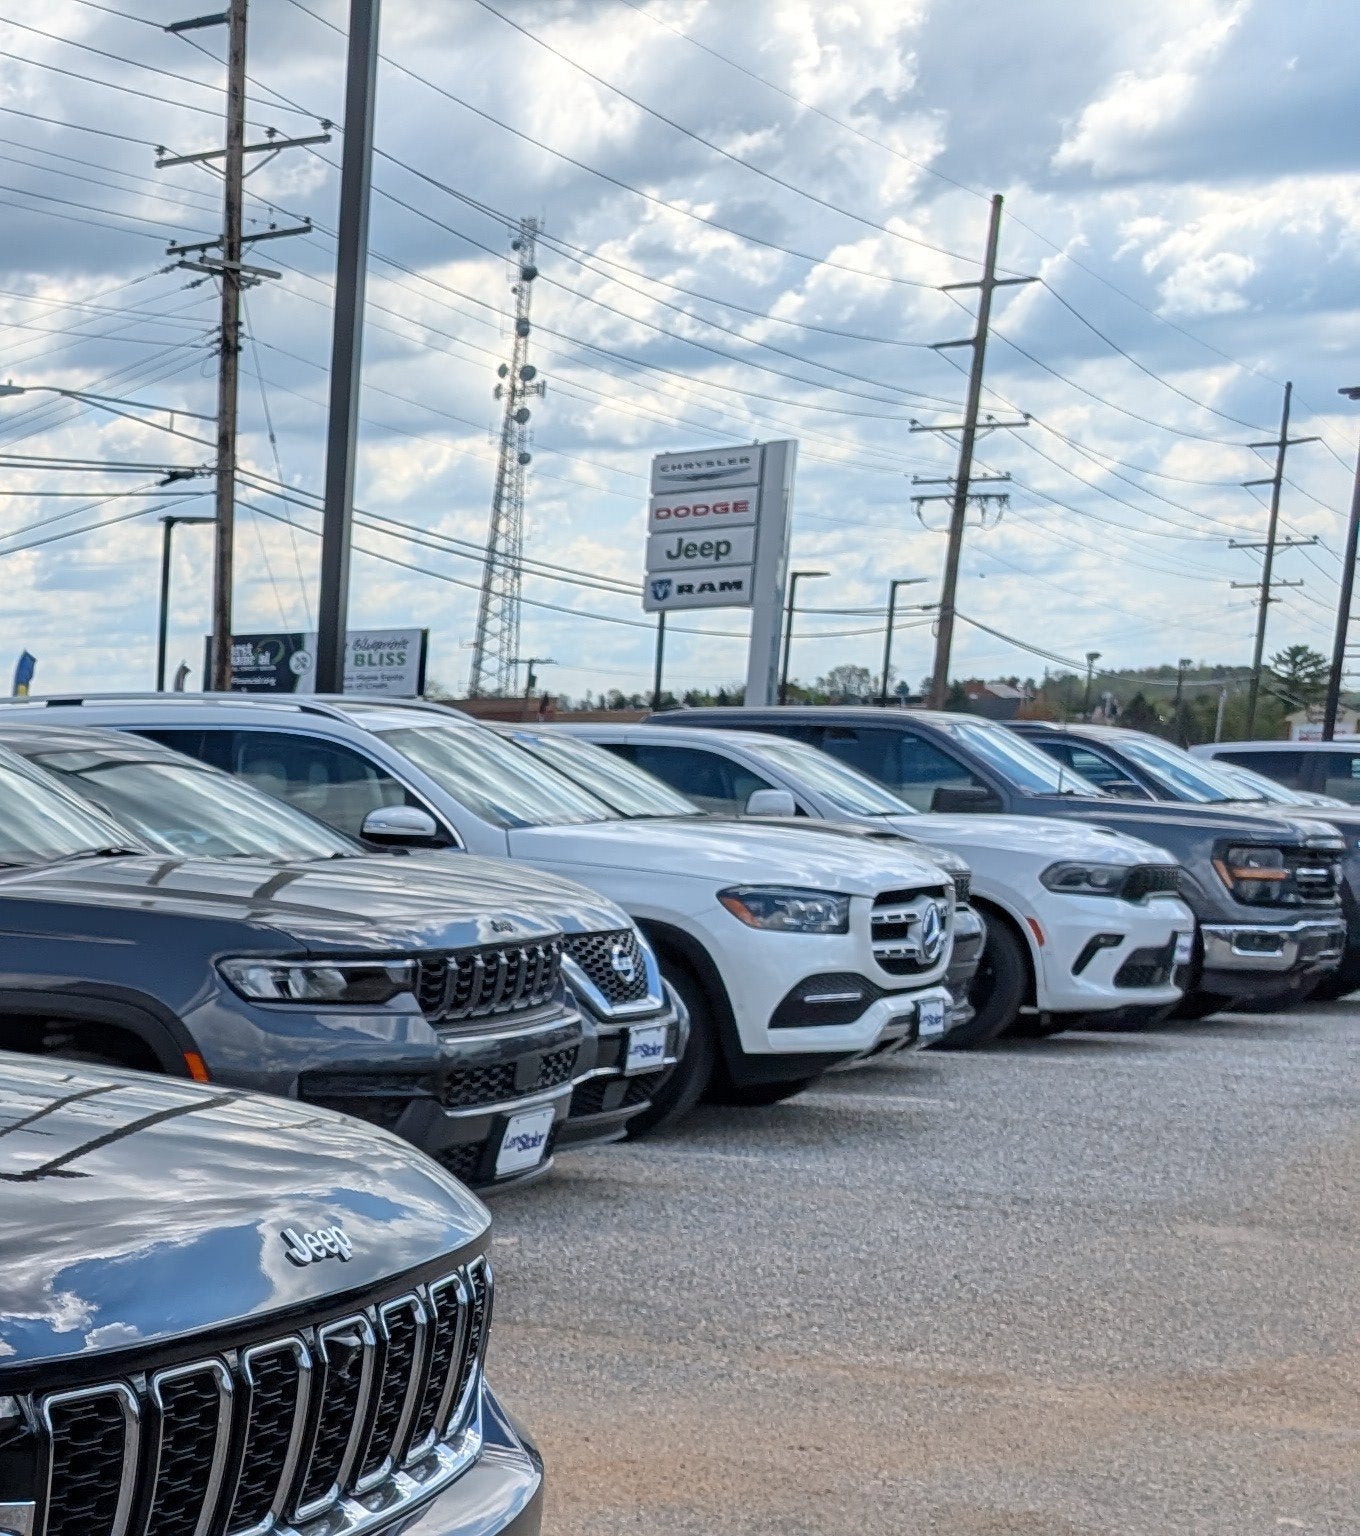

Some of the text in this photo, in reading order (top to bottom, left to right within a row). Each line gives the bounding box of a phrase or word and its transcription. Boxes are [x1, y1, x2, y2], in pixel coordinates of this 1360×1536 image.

[655, 499, 749, 520] DODGE
[665, 536, 732, 561] Jeep
[676, 579, 744, 596] RAM
[353, 651, 407, 668] BLISS
[281, 1226, 353, 1264] Jeep
